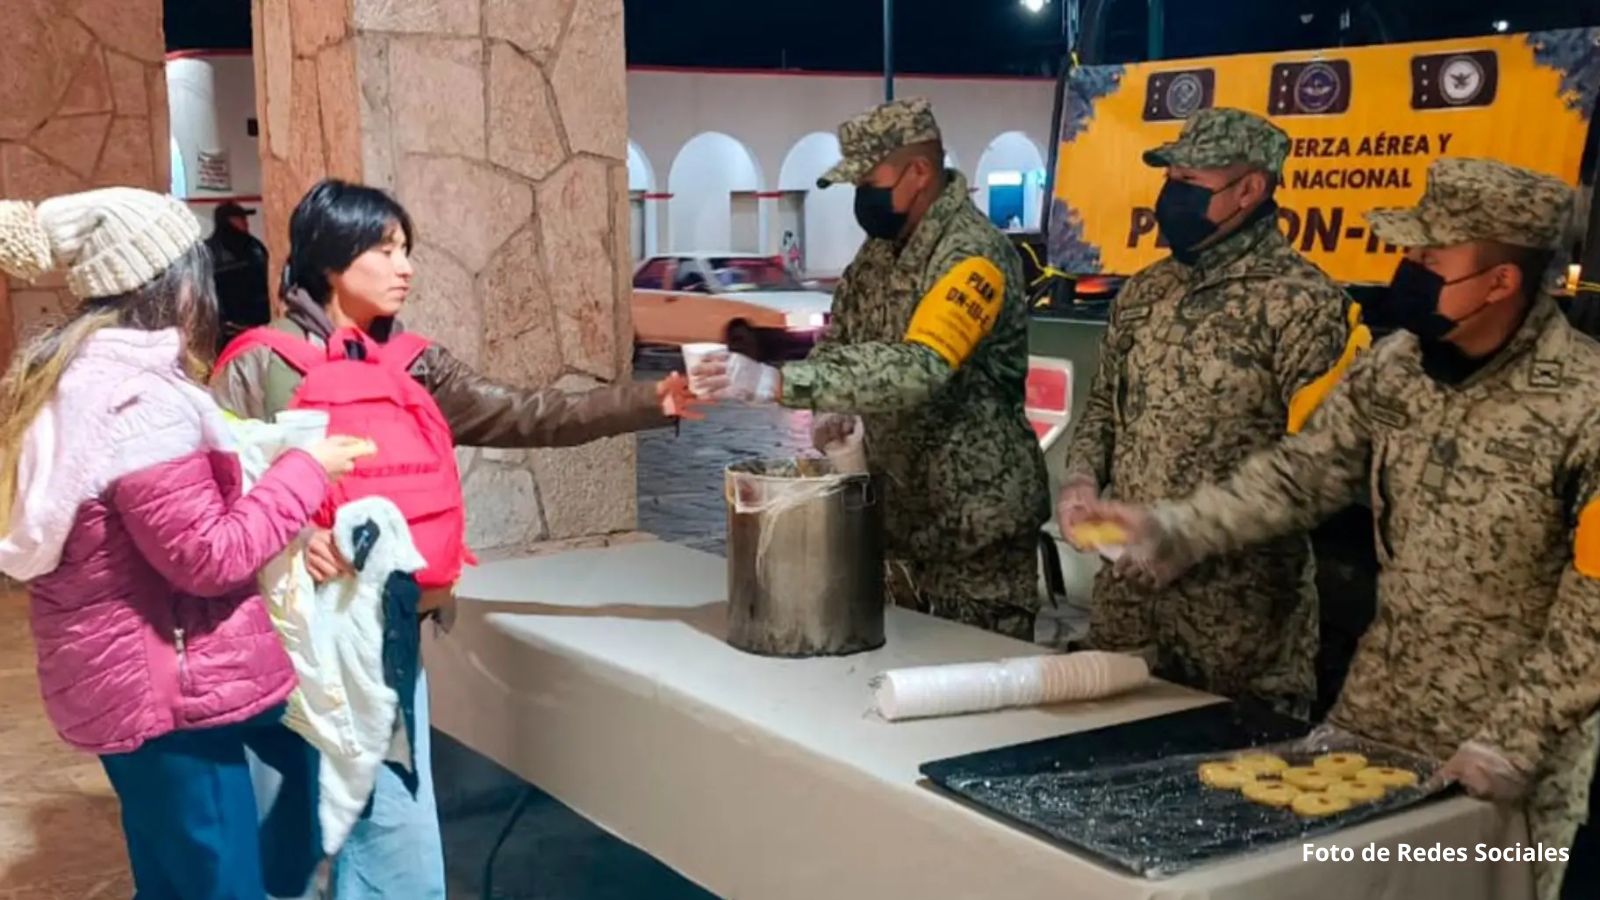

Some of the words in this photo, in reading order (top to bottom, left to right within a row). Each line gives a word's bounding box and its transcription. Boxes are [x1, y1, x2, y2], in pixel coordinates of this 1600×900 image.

[1356, 132, 1430, 156] AÉREA
[1438, 133, 1452, 154] Y
[1292, 169, 1412, 189] NACIONAL
[966, 271, 996, 303] PLAN
